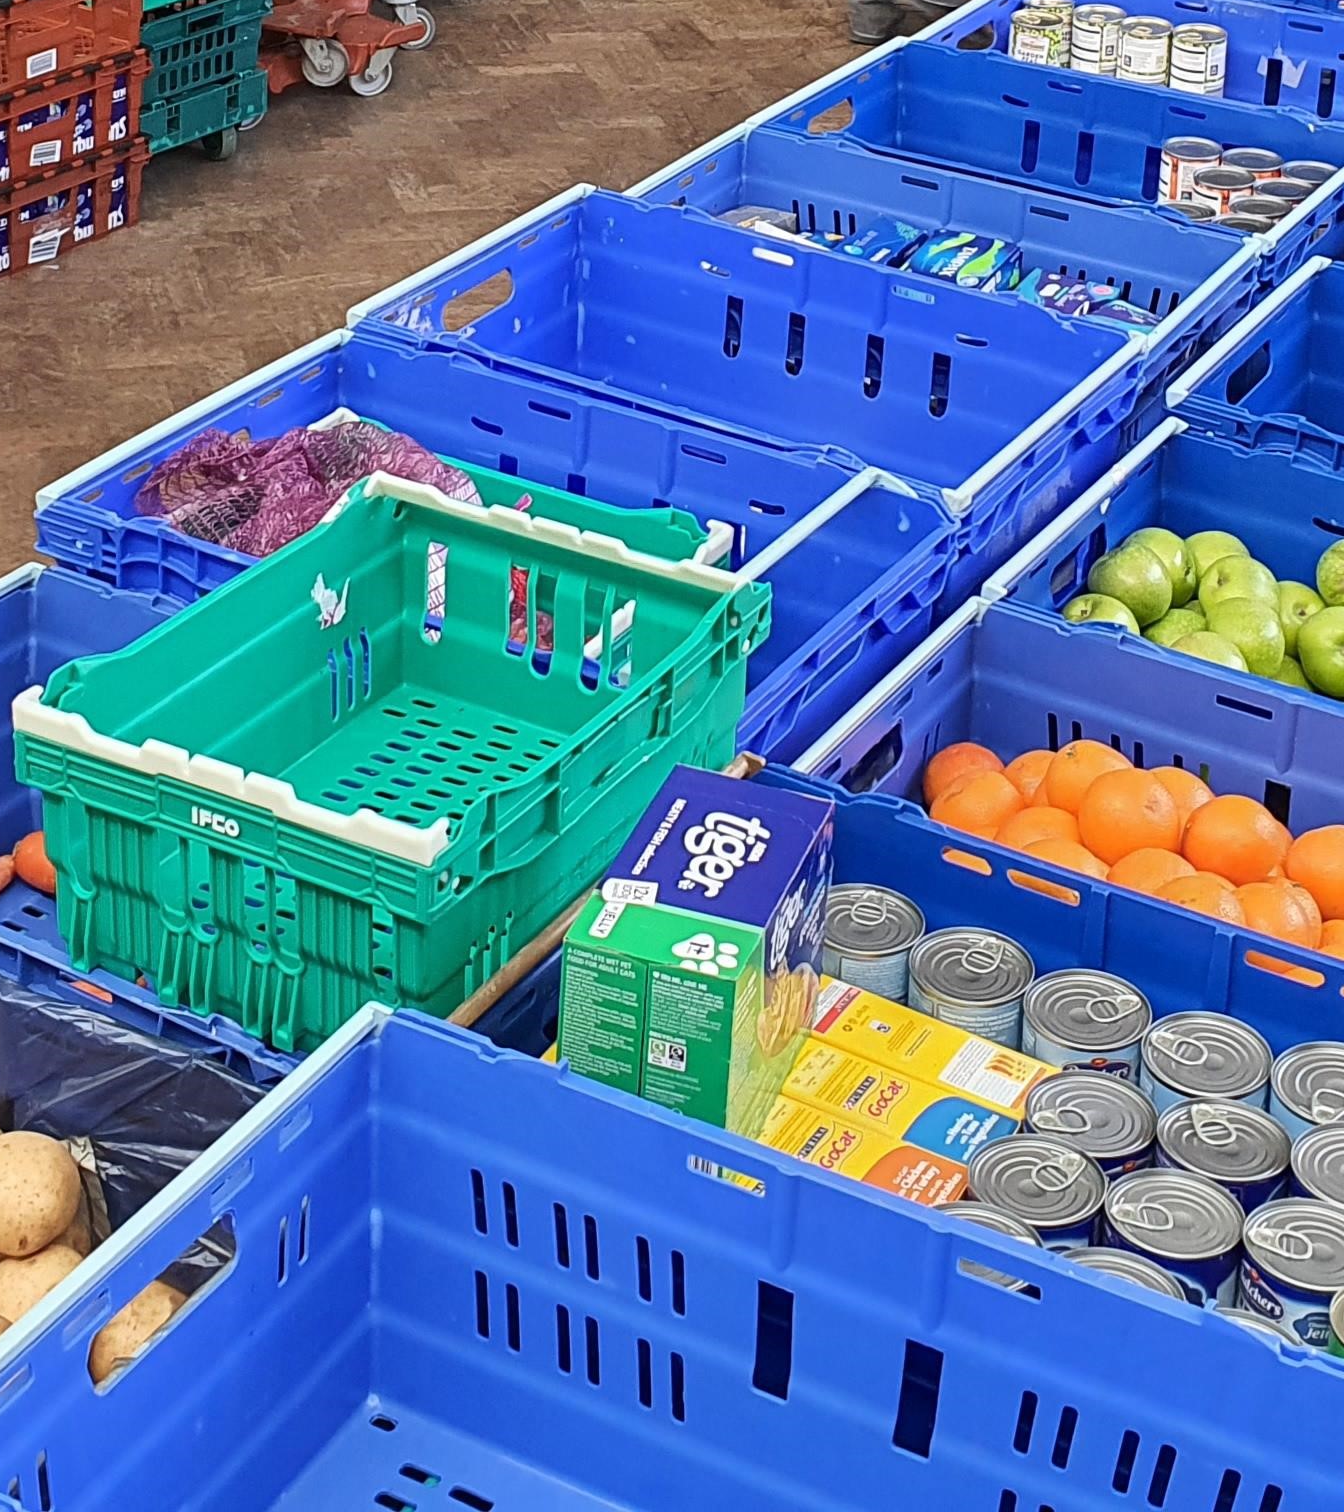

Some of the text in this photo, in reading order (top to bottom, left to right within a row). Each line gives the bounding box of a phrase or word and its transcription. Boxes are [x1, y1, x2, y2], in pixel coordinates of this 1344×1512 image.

[938, 246, 978, 278] TAMPAX
[191, 805, 240, 838] IFCO
[650, 827, 669, 846] FISH
[684, 811, 771, 898] tiger
[596, 909, 616, 935] JELLY
[573, 949, 604, 963] COMPLETE
[605, 957, 620, 968] WET
[620, 960, 632, 970] PET
[687, 941, 710, 956] 1+
[597, 963, 619, 976] ADULT
[619, 969, 636, 979] CATS
[847, 1075, 876, 1105] PURINA
[868, 1080, 903, 1117] GoCat
[820, 1129, 857, 1170] GoCat
[900, 1160, 929, 1188] Chicken
